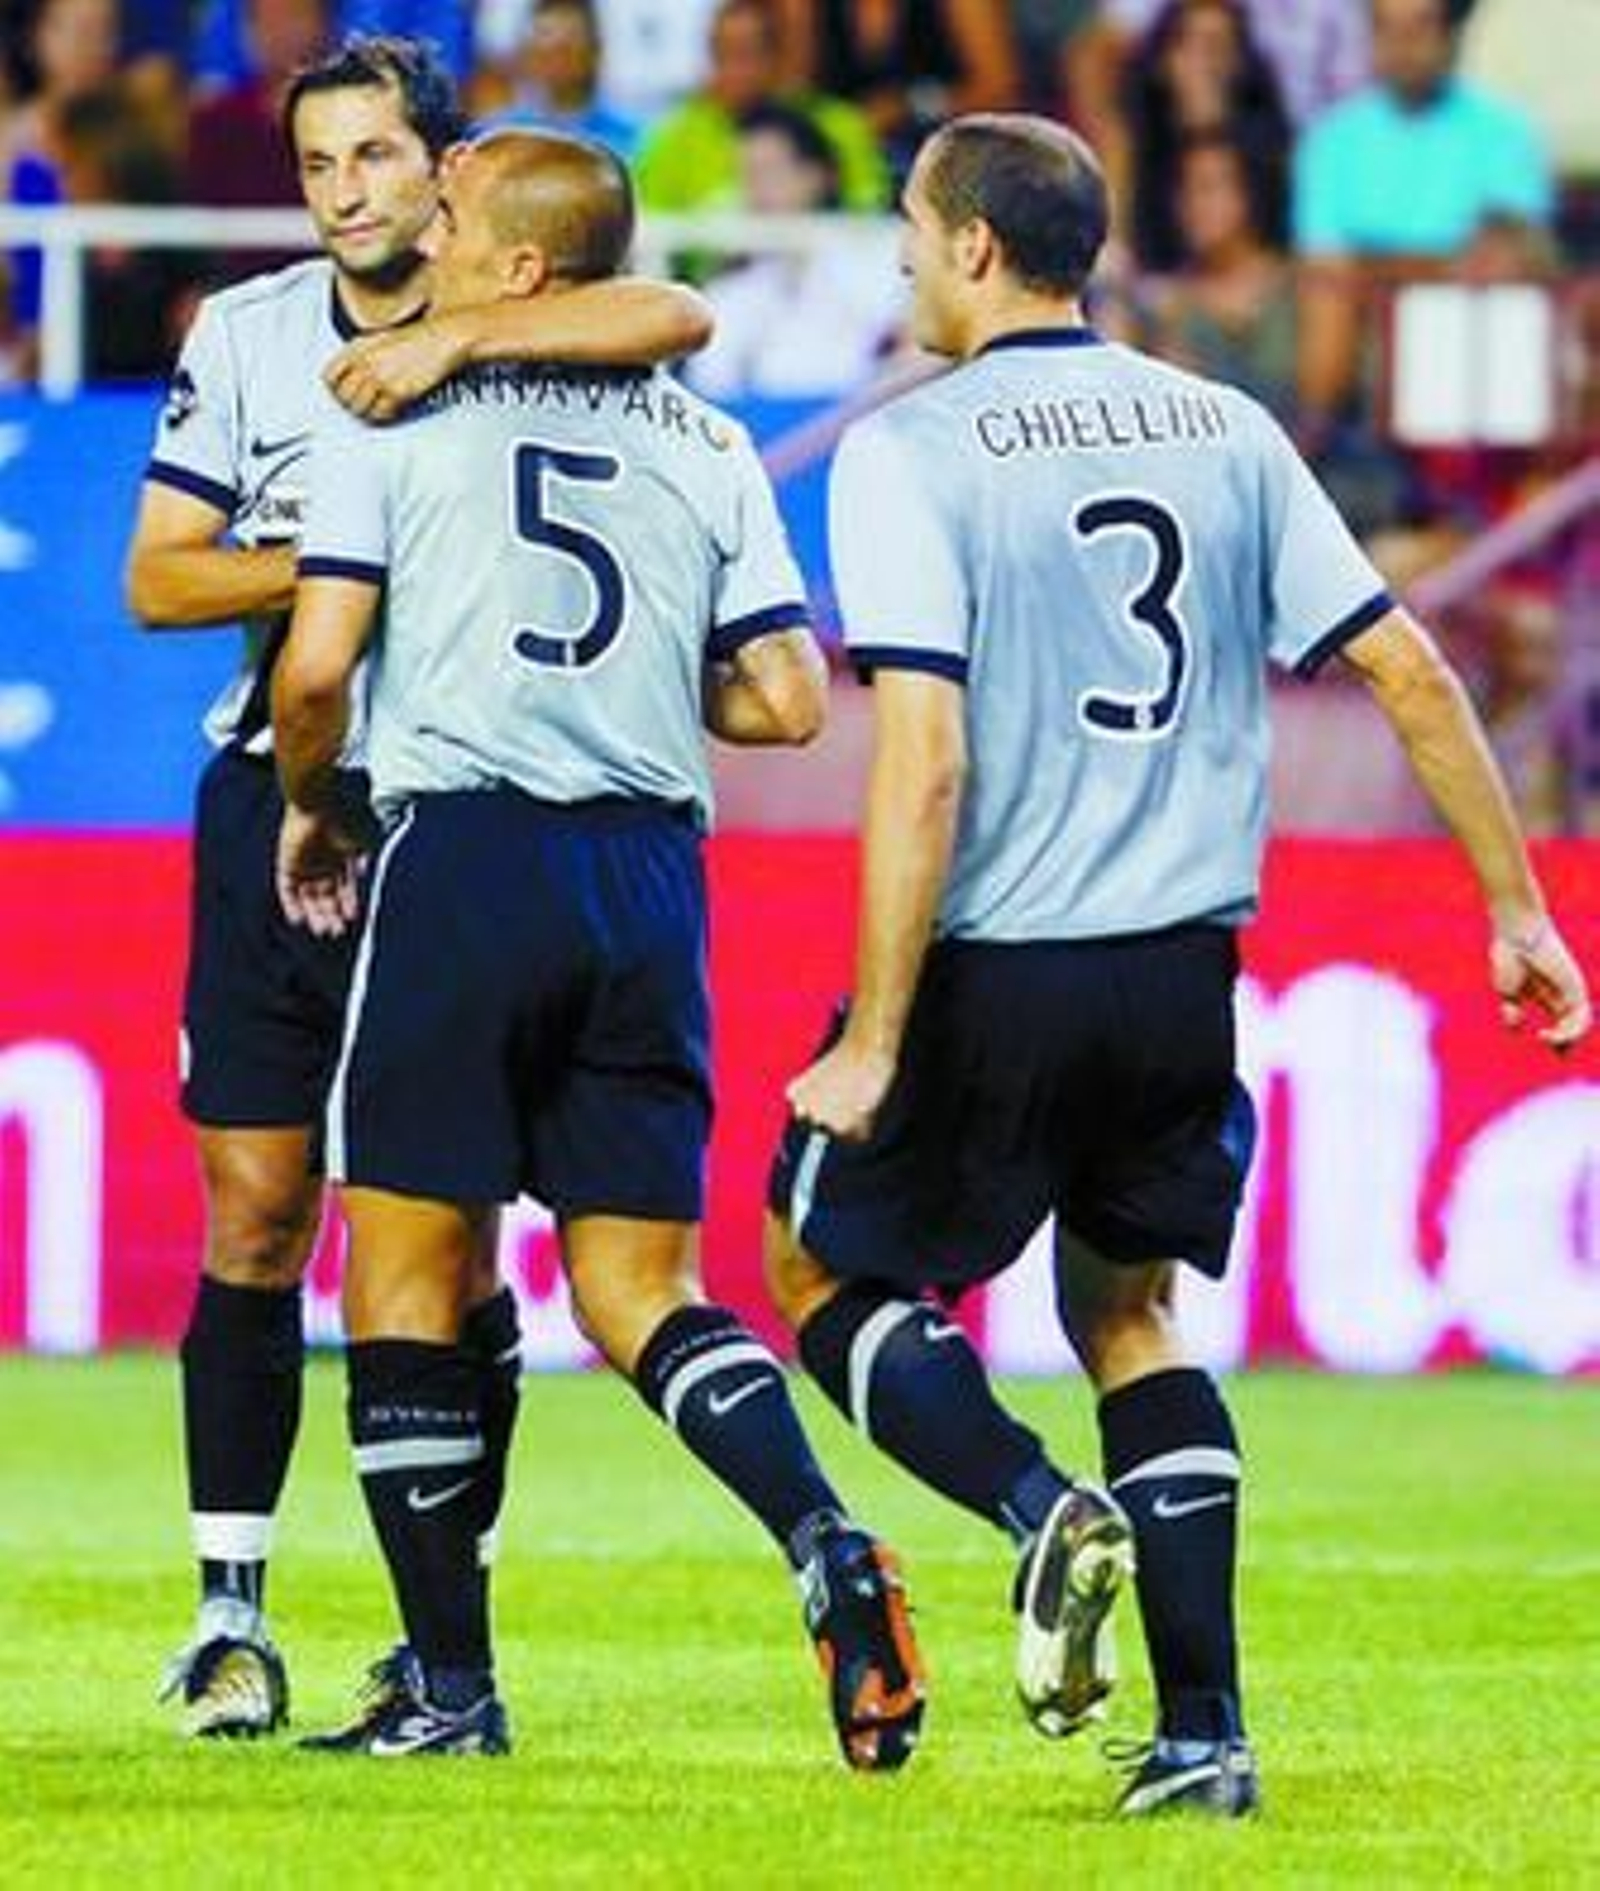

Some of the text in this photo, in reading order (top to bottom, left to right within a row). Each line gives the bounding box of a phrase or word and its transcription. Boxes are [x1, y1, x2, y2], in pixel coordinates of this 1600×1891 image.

[975, 395, 1226, 457] CHIELLINI
[510, 438, 629, 670] 5
[1071, 492, 1189, 735] 3
